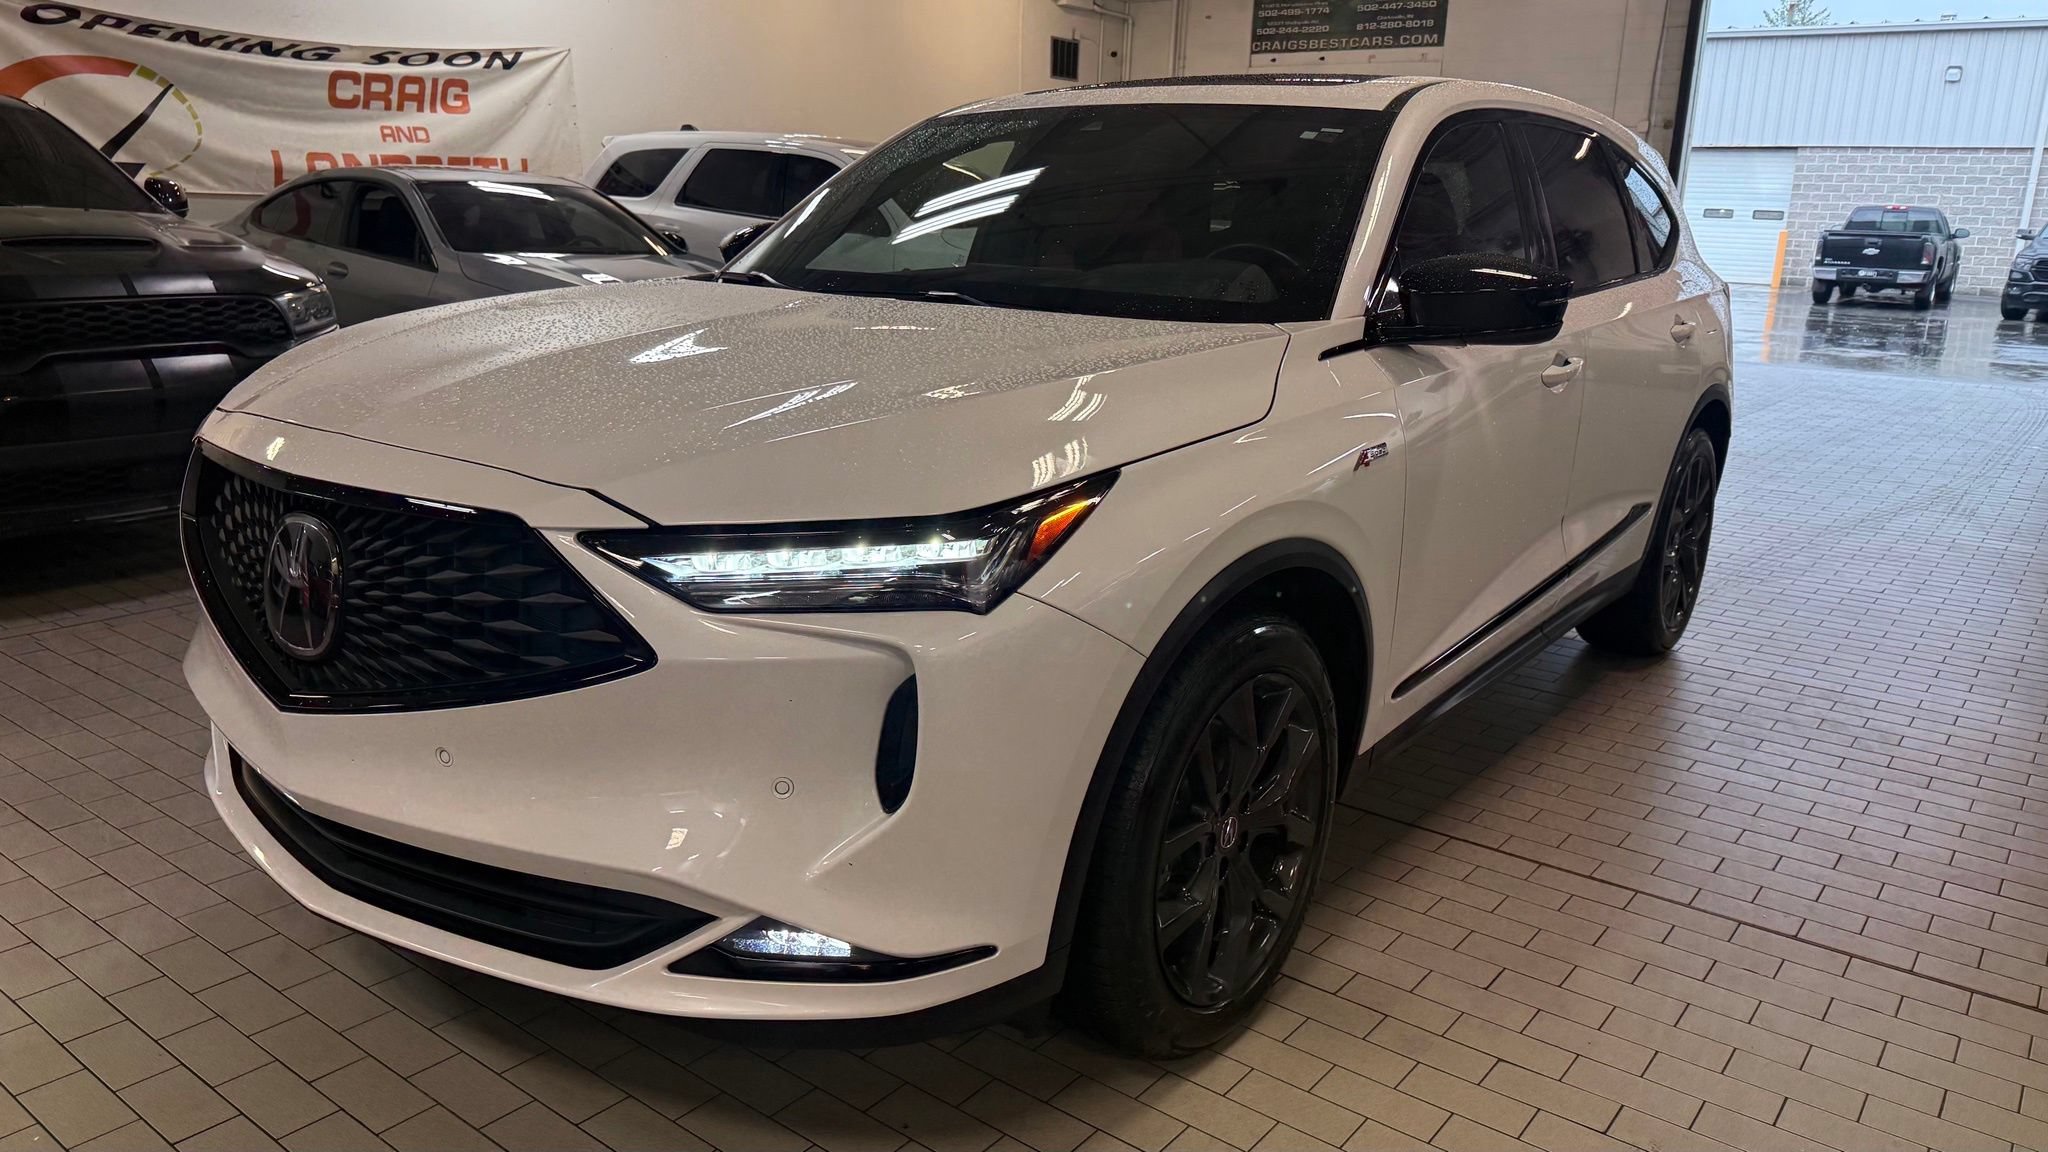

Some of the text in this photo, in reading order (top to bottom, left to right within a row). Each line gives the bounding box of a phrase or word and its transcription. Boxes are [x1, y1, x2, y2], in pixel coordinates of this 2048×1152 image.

[1357, 0, 1437, 12] 502-447-3450
[20, 3, 523, 71] OPENING SOON
[1252, 34, 1439, 52] CRAIGSBESTCARS.COM
[327, 70, 471, 115] CRAIG
[380, 124, 431, 144] AND
